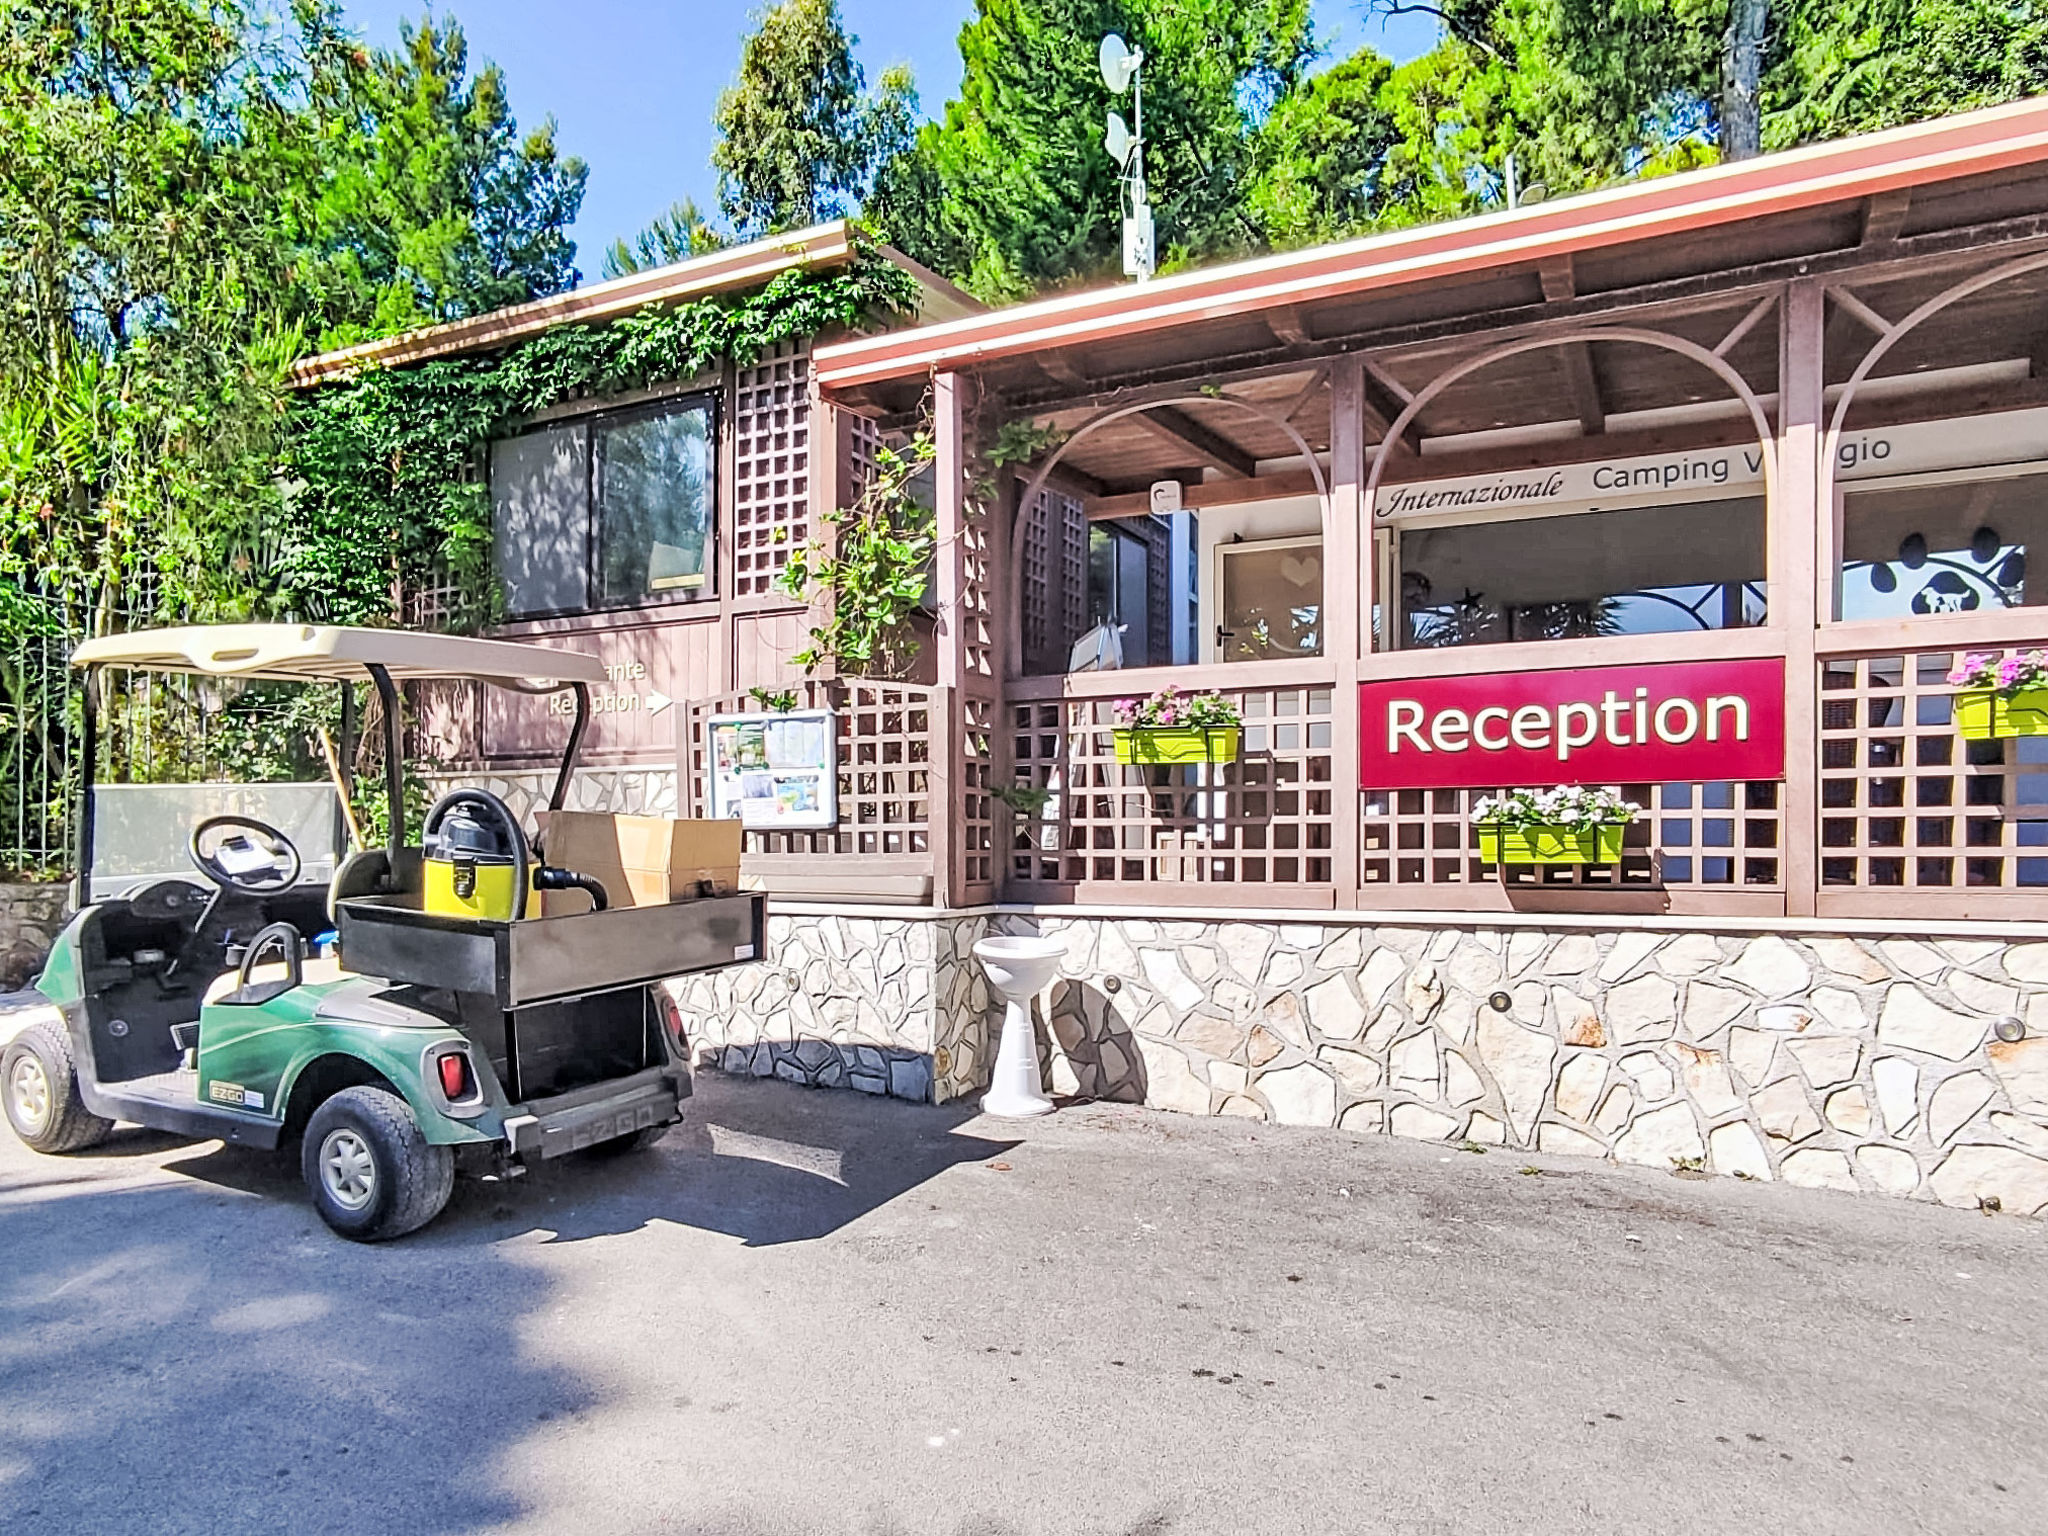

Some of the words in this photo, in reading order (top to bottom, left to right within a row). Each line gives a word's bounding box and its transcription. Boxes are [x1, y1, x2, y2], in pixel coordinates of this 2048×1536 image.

[1376, 471, 1563, 518] Internazionale
[1592, 457, 1729, 490] Camping
[550, 691, 641, 717] Recption
[1387, 687, 1749, 761] Reception
